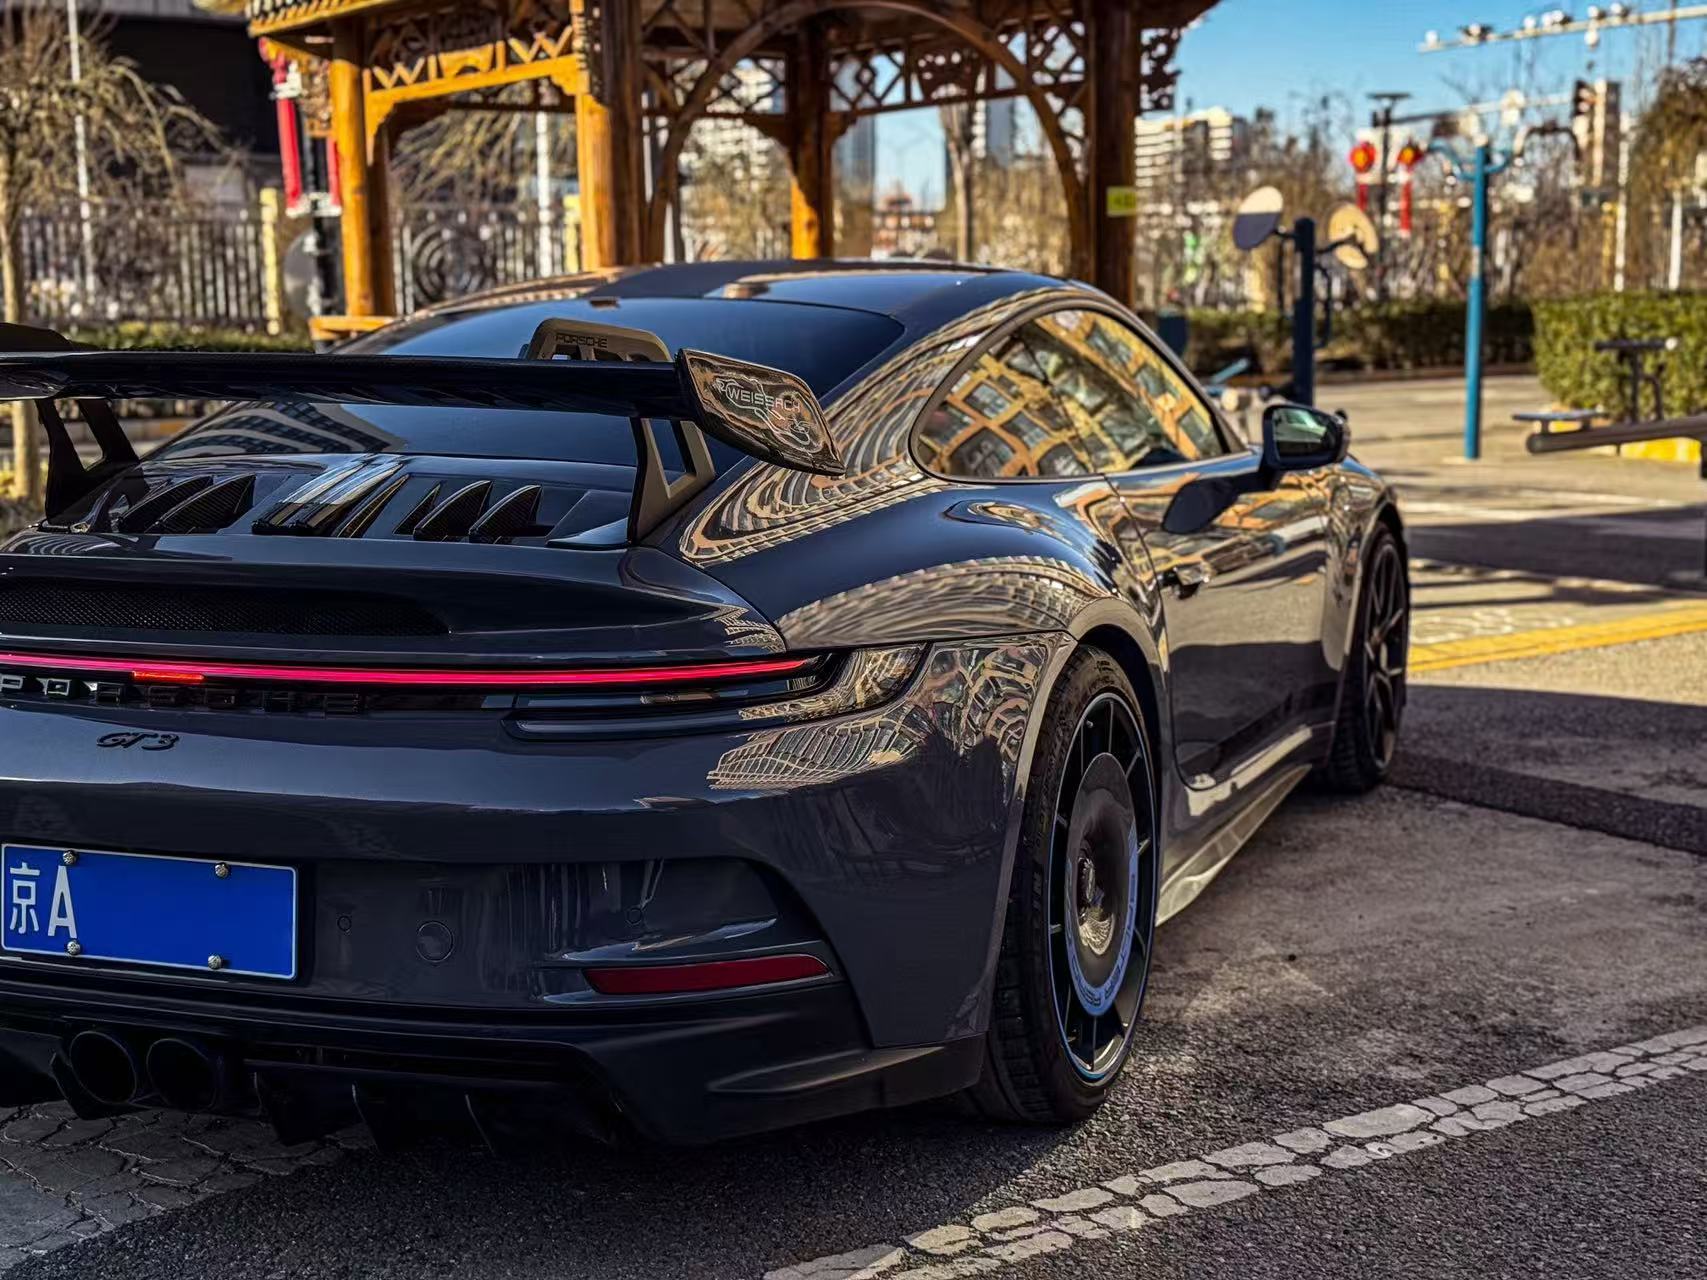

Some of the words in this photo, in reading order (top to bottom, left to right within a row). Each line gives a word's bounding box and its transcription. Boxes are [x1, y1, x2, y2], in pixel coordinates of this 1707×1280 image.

[555, 334, 608, 349] PORSCHE
[728, 386, 801, 412] WEISSACH
[96, 730, 180, 751] GT3
[9, 861, 78, 939] 京A
